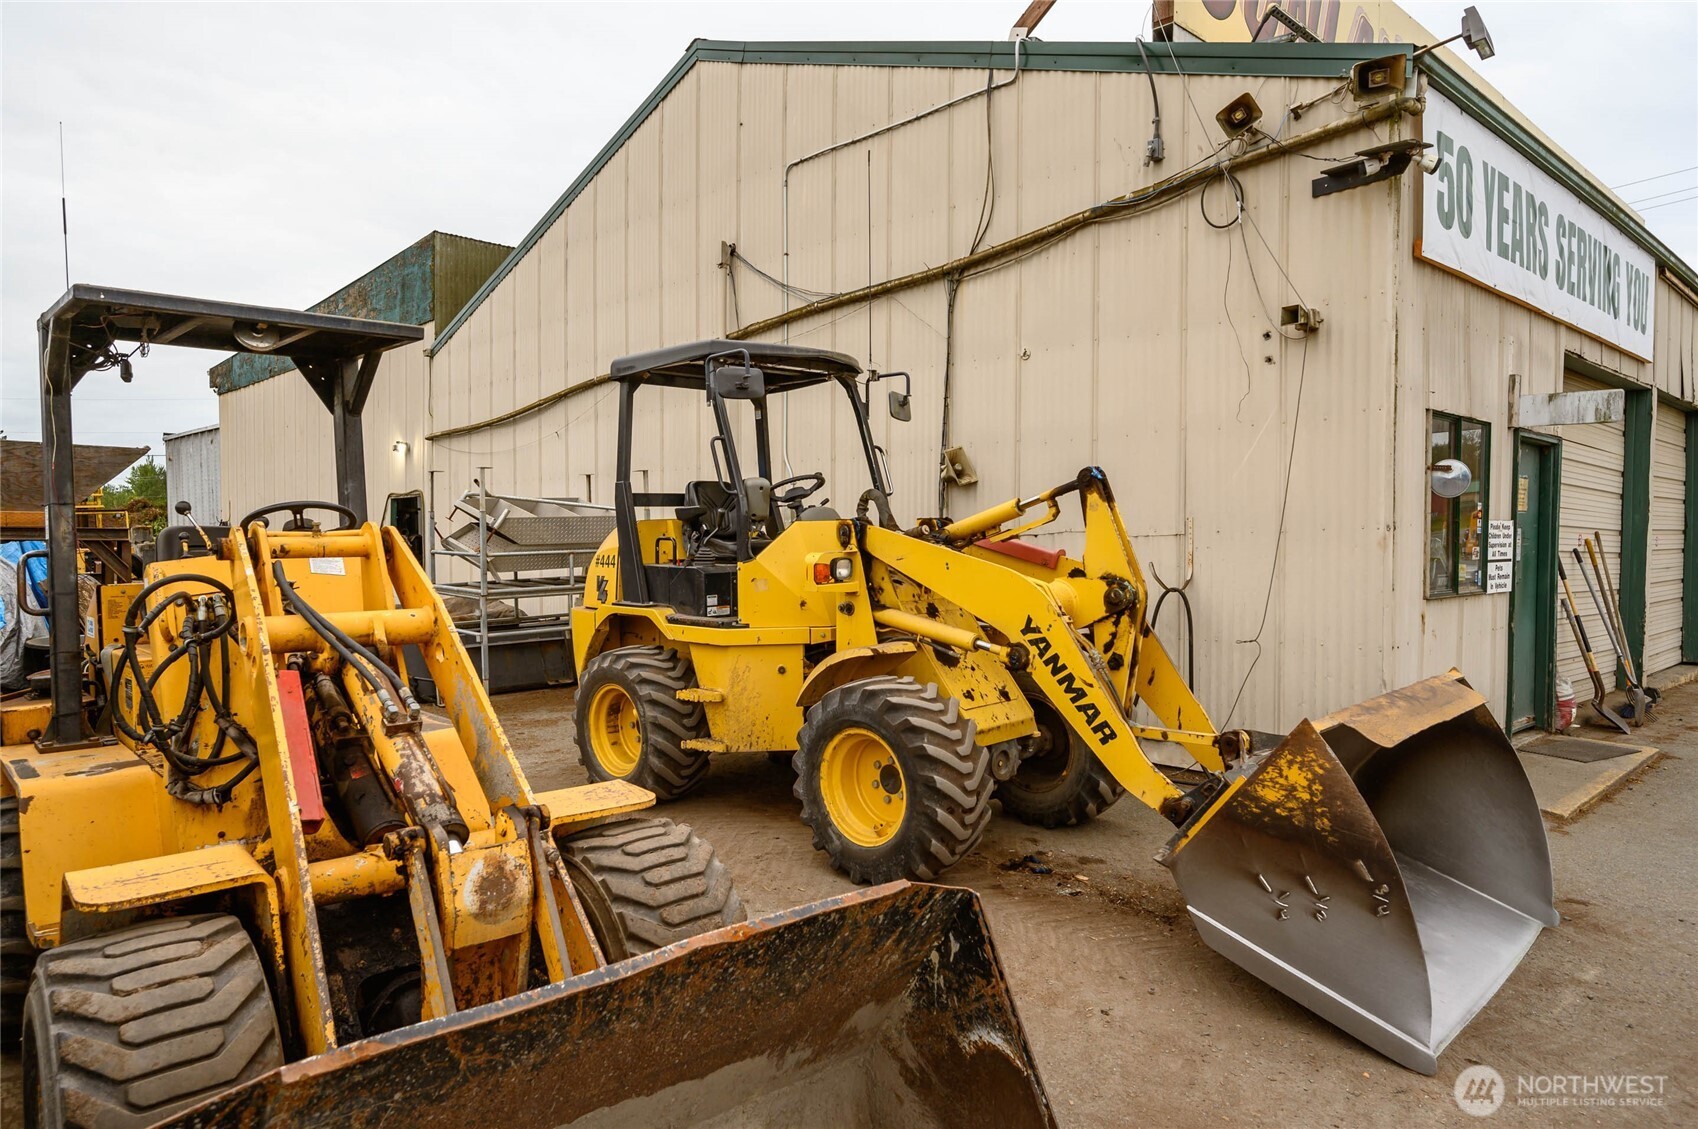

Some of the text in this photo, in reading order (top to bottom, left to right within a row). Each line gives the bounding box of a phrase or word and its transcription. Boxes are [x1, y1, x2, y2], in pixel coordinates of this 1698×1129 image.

[1437, 129, 1649, 335] 50 YEARS SERVING YOU
[1501, 523, 1511, 531] Keep
[595, 555, 616, 568] #444
[1497, 572, 1510, 580] Remain
[1495, 581, 1508, 589] Vehicle
[1020, 614, 1117, 746] YANMAR
